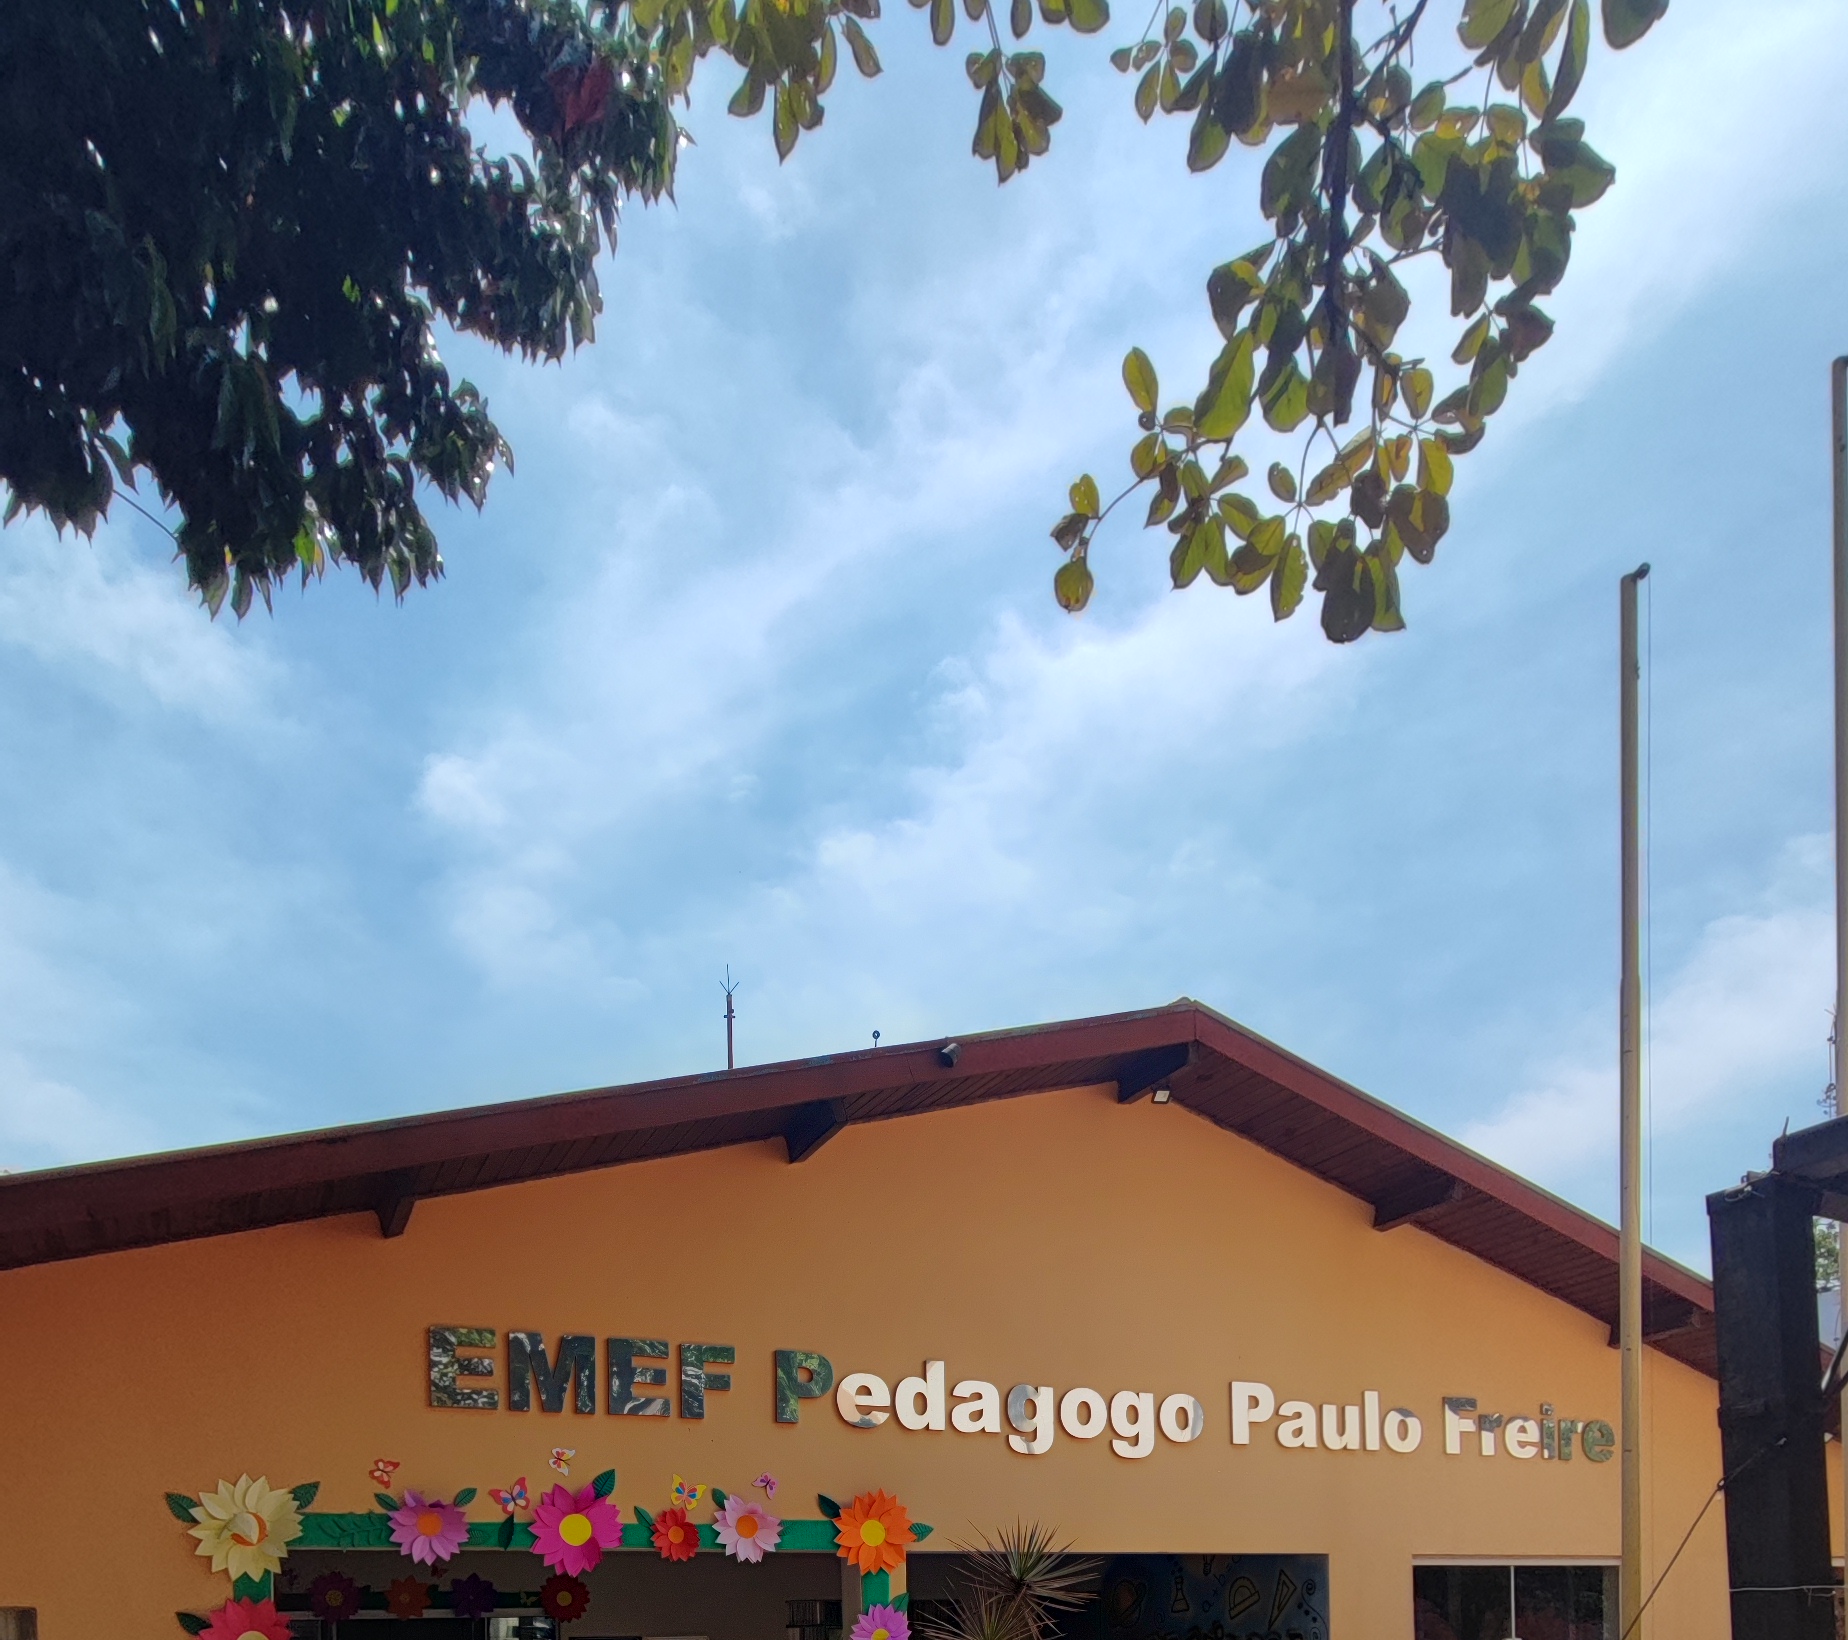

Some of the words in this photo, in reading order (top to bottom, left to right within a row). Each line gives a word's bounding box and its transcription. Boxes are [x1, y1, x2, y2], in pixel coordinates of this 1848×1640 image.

[429, 1325, 735, 1420] EMEF
[775, 1349, 1204, 1459] Pedagogo
[1230, 1380, 1422, 1454] Paulo
[1442, 1395, 1616, 1463] Freire
